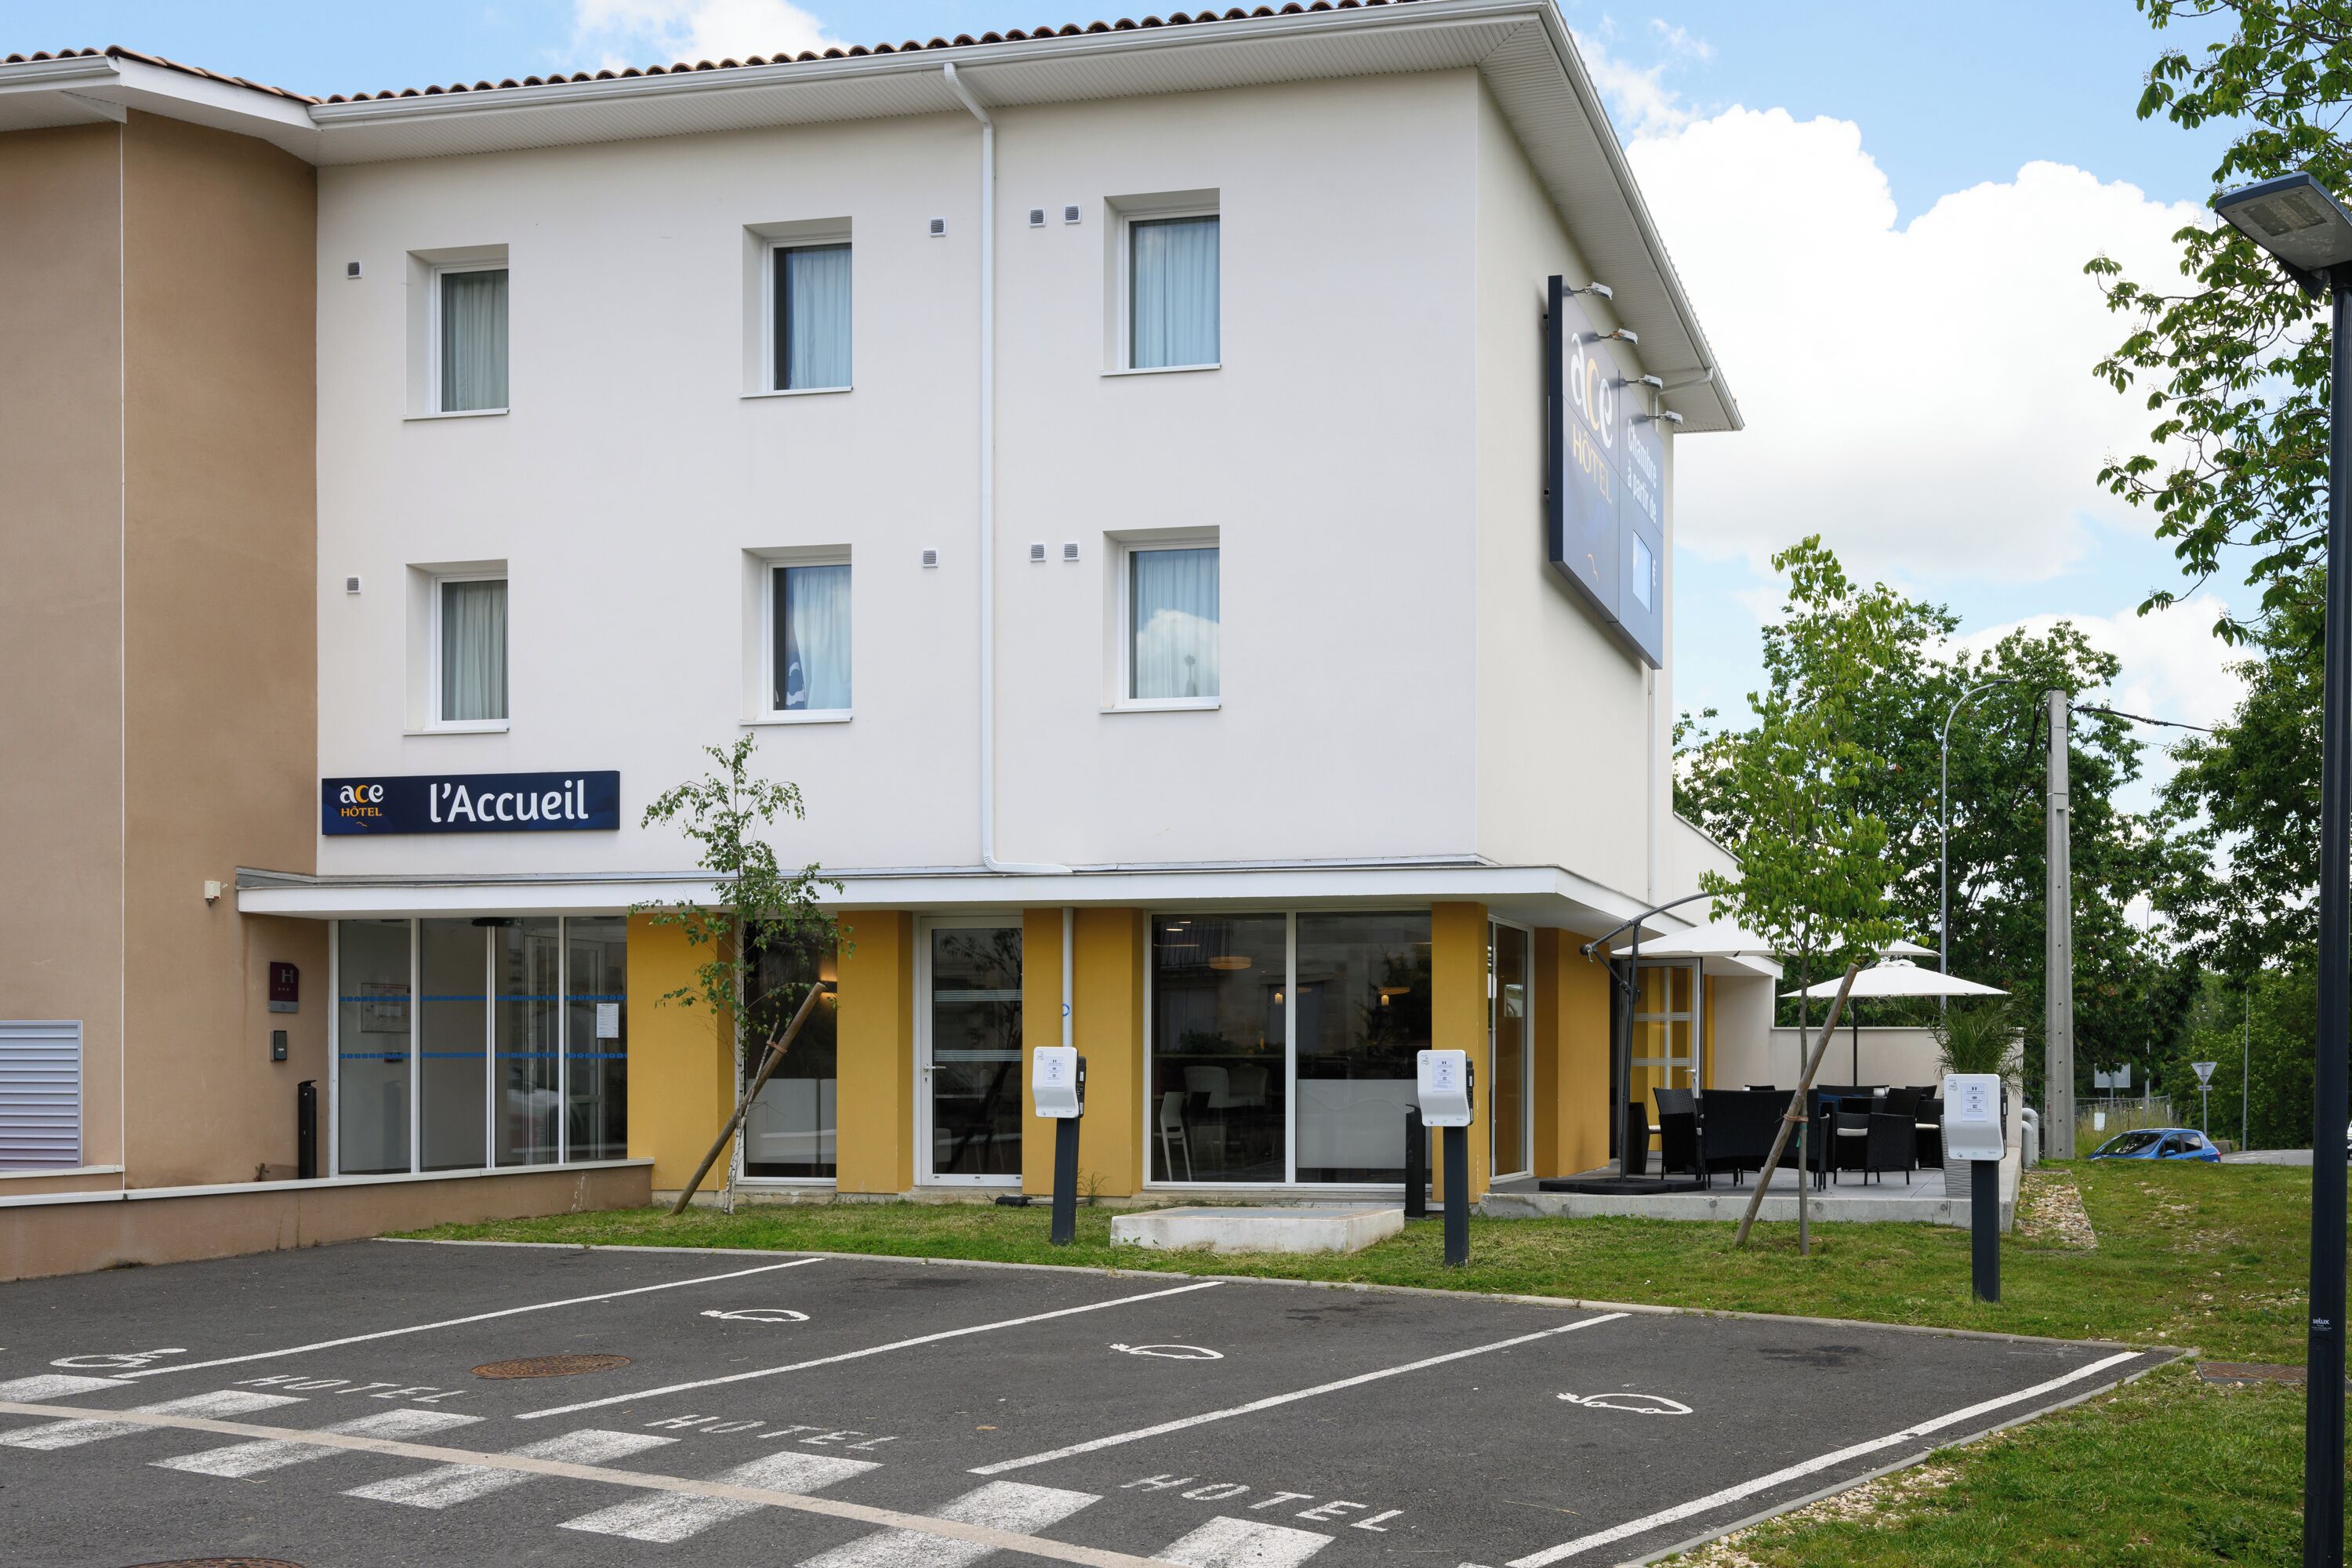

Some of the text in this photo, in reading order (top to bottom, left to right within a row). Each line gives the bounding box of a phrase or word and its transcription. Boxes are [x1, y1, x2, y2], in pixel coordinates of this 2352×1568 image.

[1570, 332, 1613, 449] ace
[1573, 423, 1612, 506] HÔTEL
[1628, 418, 1657, 488] Chambre
[1633, 472, 1648, 513] partir
[1650, 494, 1657, 524] de
[339, 784, 383, 804] ace
[341, 805, 382, 817] HÔTEL
[430, 779, 589, 823] l'Accueil
[282, 969, 294, 983] H
[236, 1374, 467, 1403] HOTEL
[644, 1414, 900, 1451] HOTEL
[1120, 1472, 1405, 1532] HOTEL
